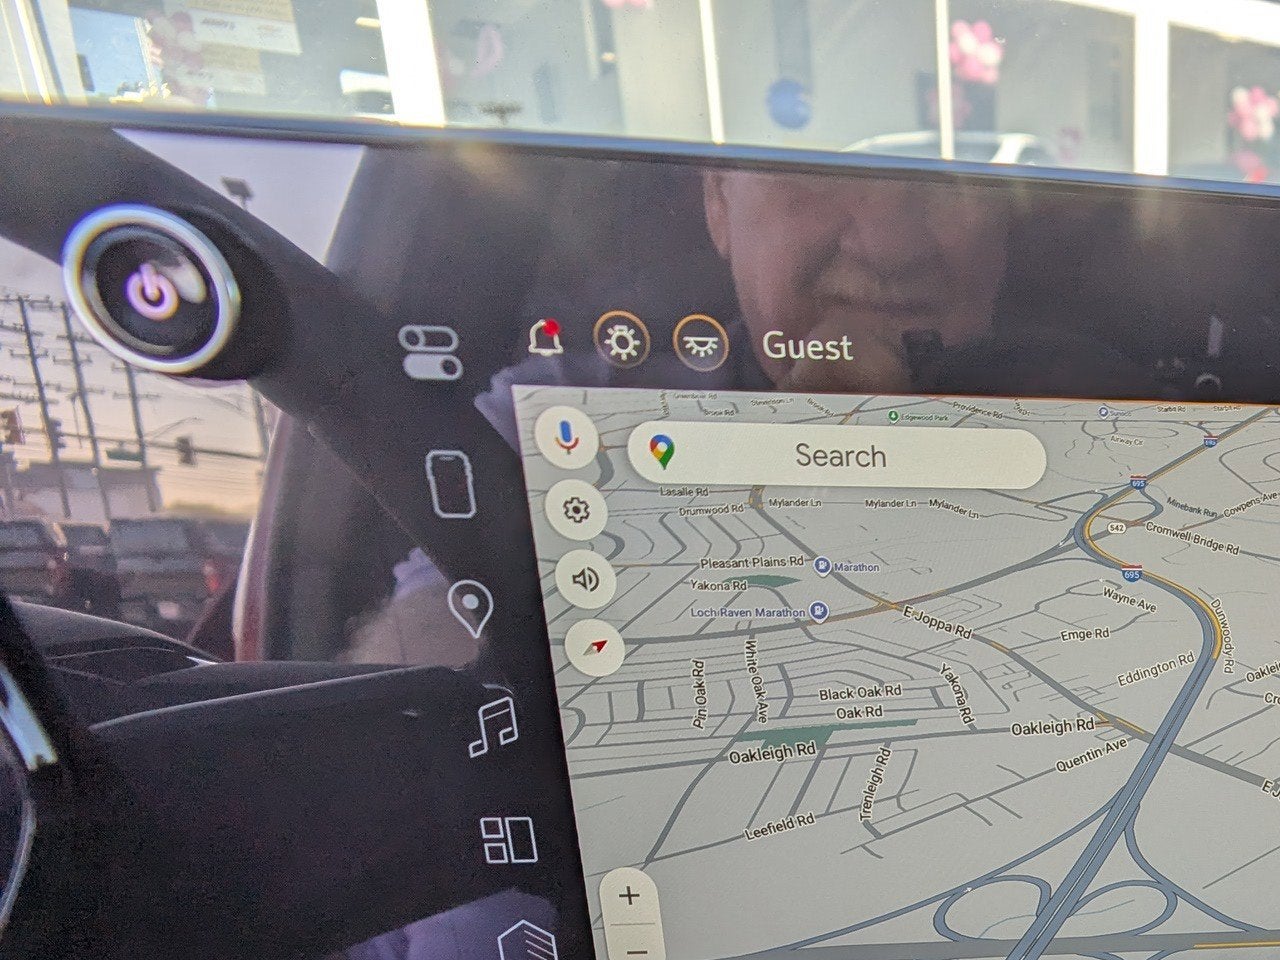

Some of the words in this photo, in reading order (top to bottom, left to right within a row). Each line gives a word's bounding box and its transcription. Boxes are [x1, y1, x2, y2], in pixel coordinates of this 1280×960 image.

[763, 331, 854, 362] Guest
[900, 413, 932, 423] Edgewood
[933, 413, 949, 422] Park
[953, 401, 992, 419] Providence
[992, 410, 1003, 420] Rd
[795, 442, 887, 468] Search
[660, 486, 694, 497] Lasalle
[696, 486, 709, 497] Rd
[679, 504, 730, 517] Drumwood
[733, 503, 744, 514] Rd
[769, 498, 809, 509] Mylander
[811, 498, 822, 508] Ln
[865, 498, 904, 509] Mylander
[905, 499, 917, 508] Ln
[929, 498, 967, 517] Mylander
[967, 509, 980, 520] Ln
[1167, 496, 1200, 515] Minebank
[1201, 507, 1218, 519] Run
[1223, 497, 1261, 518] Cowpens
[1261, 491, 1278, 504] Ave
[1110, 523, 1124, 533] 542
[1146, 520, 1191, 542] Cromwell
[1193, 534, 1224, 554] Bridge
[1225, 542, 1240, 556] Rd
[701, 557, 750, 570] Pleasant
[752, 556, 787, 568] Plains
[789, 555, 804, 567] Rd
[834, 562, 880, 572] Marathon
[690, 579, 731, 592] Yakona
[733, 579, 747, 591] Rd
[1124, 570, 1140, 579] 695
[1103, 586, 1136, 607] Wayne
[1137, 599, 1157, 613] Ave
[691, 607, 716, 618] Loch
[720, 607, 751, 618] Raven
[755, 607, 806, 618] Marathon
[902, 606, 911, 618] E
[912, 609, 952, 632] Joppa
[953, 625, 972, 639] Rd
[1060, 628, 1092, 642] Emge
[1094, 627, 1110, 640] Rd
[1210, 598, 1235, 658] Dunwoody
[1223, 658, 1234, 674] Rd
[745, 639, 758, 674] White
[691, 659, 705, 677] Rd
[1117, 659, 1177, 687] Eddington
[1178, 651, 1195, 666] Rd
[693, 680, 707, 705] Oak
[750, 675, 766, 697] Oak
[819, 688, 855, 701] Black
[858, 686, 882, 698] Oak
[884, 685, 902, 697] Rd
[939, 663, 966, 706] Yakona
[959, 705, 976, 724] Rd
[693, 707, 708, 729] Pin
[757, 702, 768, 724] Ave
[836, 707, 861, 720] Oak
[865, 705, 883, 717] Rd
[1011, 720, 1074, 740] Oakleigh
[1075, 718, 1095, 733] Rd
[729, 744, 794, 764] Oakleigh
[796, 742, 816, 756] Rd
[1056, 747, 1102, 772] Quentin
[1103, 737, 1128, 755] Ave
[859, 763, 886, 821] Trenleigh
[875, 747, 892, 763] Rd
[1261, 780, 1273, 793] E
[744, 818, 795, 841] Leefield
[797, 813, 816, 826] Rd
